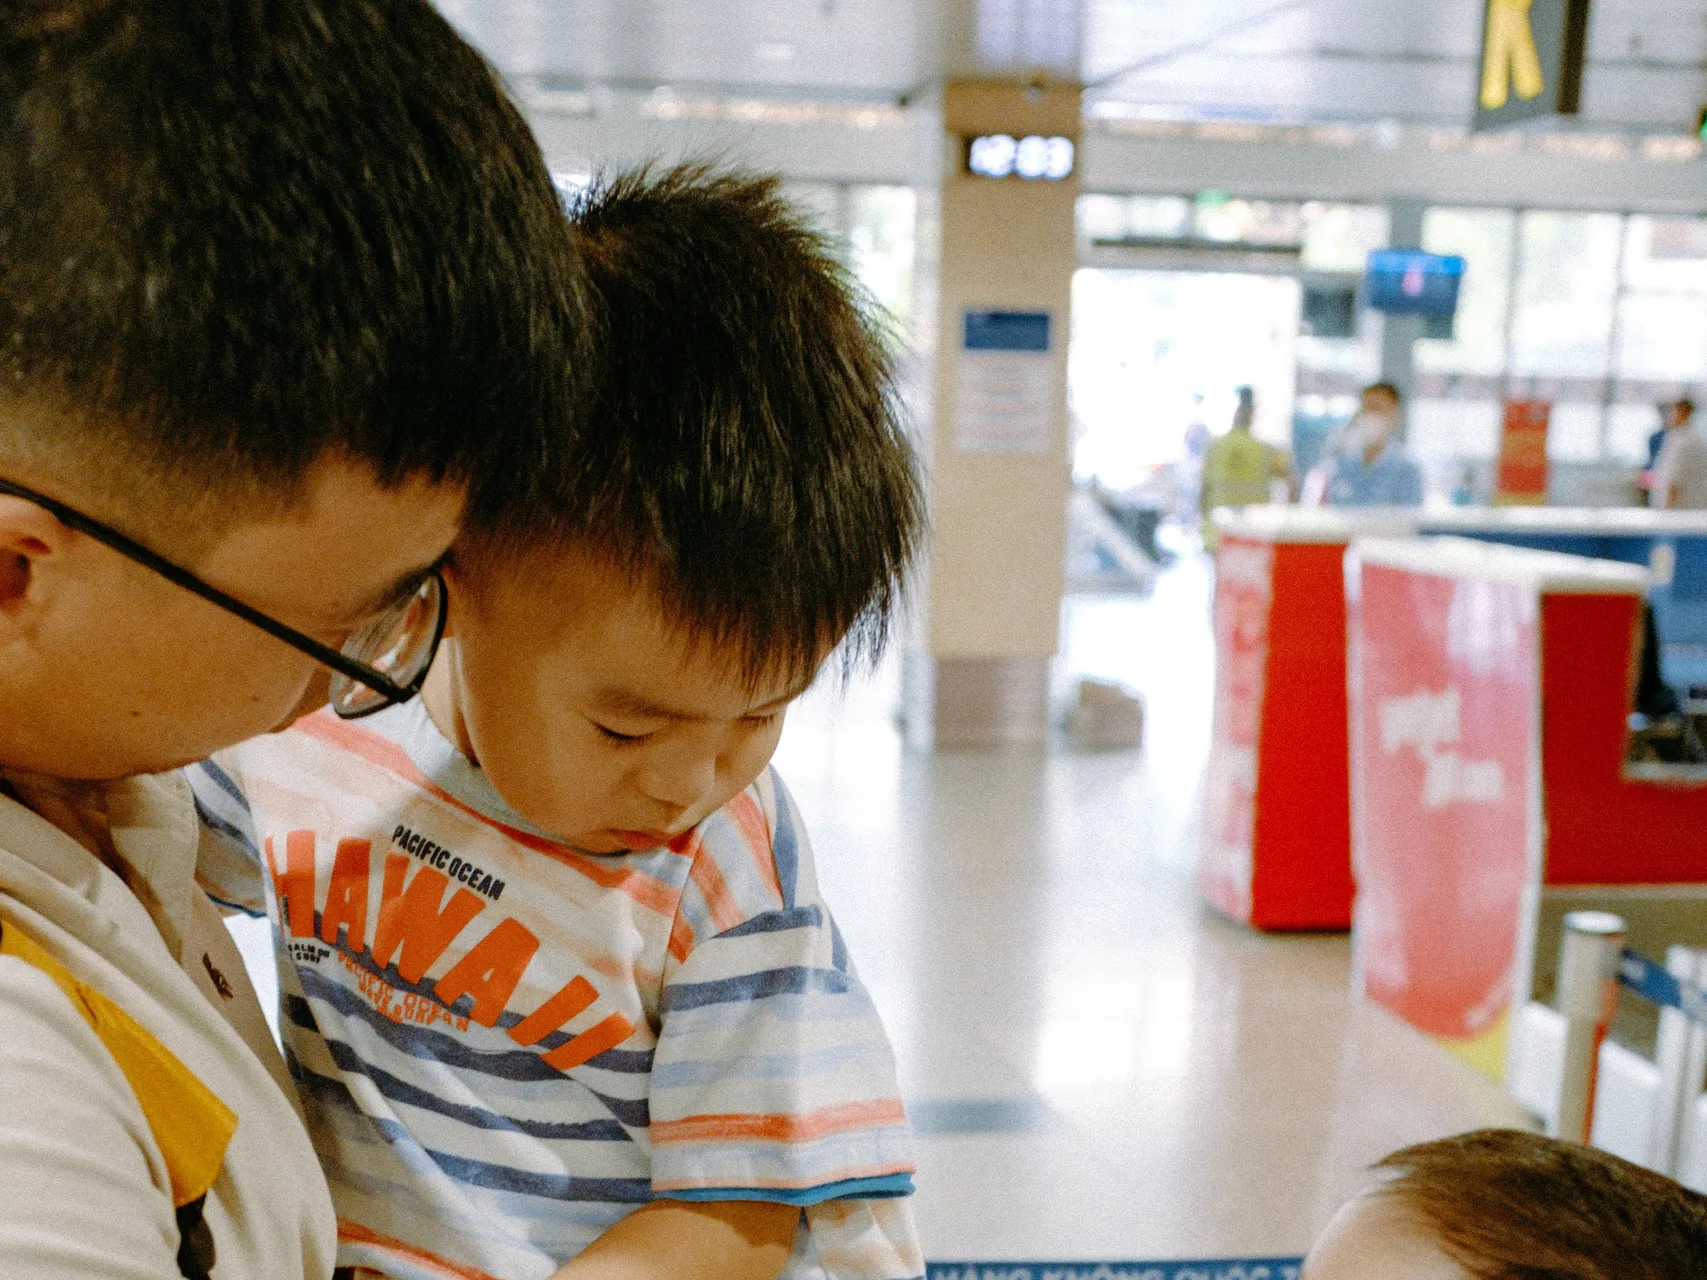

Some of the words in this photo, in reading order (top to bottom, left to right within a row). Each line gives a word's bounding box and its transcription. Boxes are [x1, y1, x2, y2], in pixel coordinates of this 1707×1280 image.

[392, 824, 450, 869] PACIFIC
[448, 857, 505, 901] OCEAN
[265, 830, 637, 1071] HAWAII
